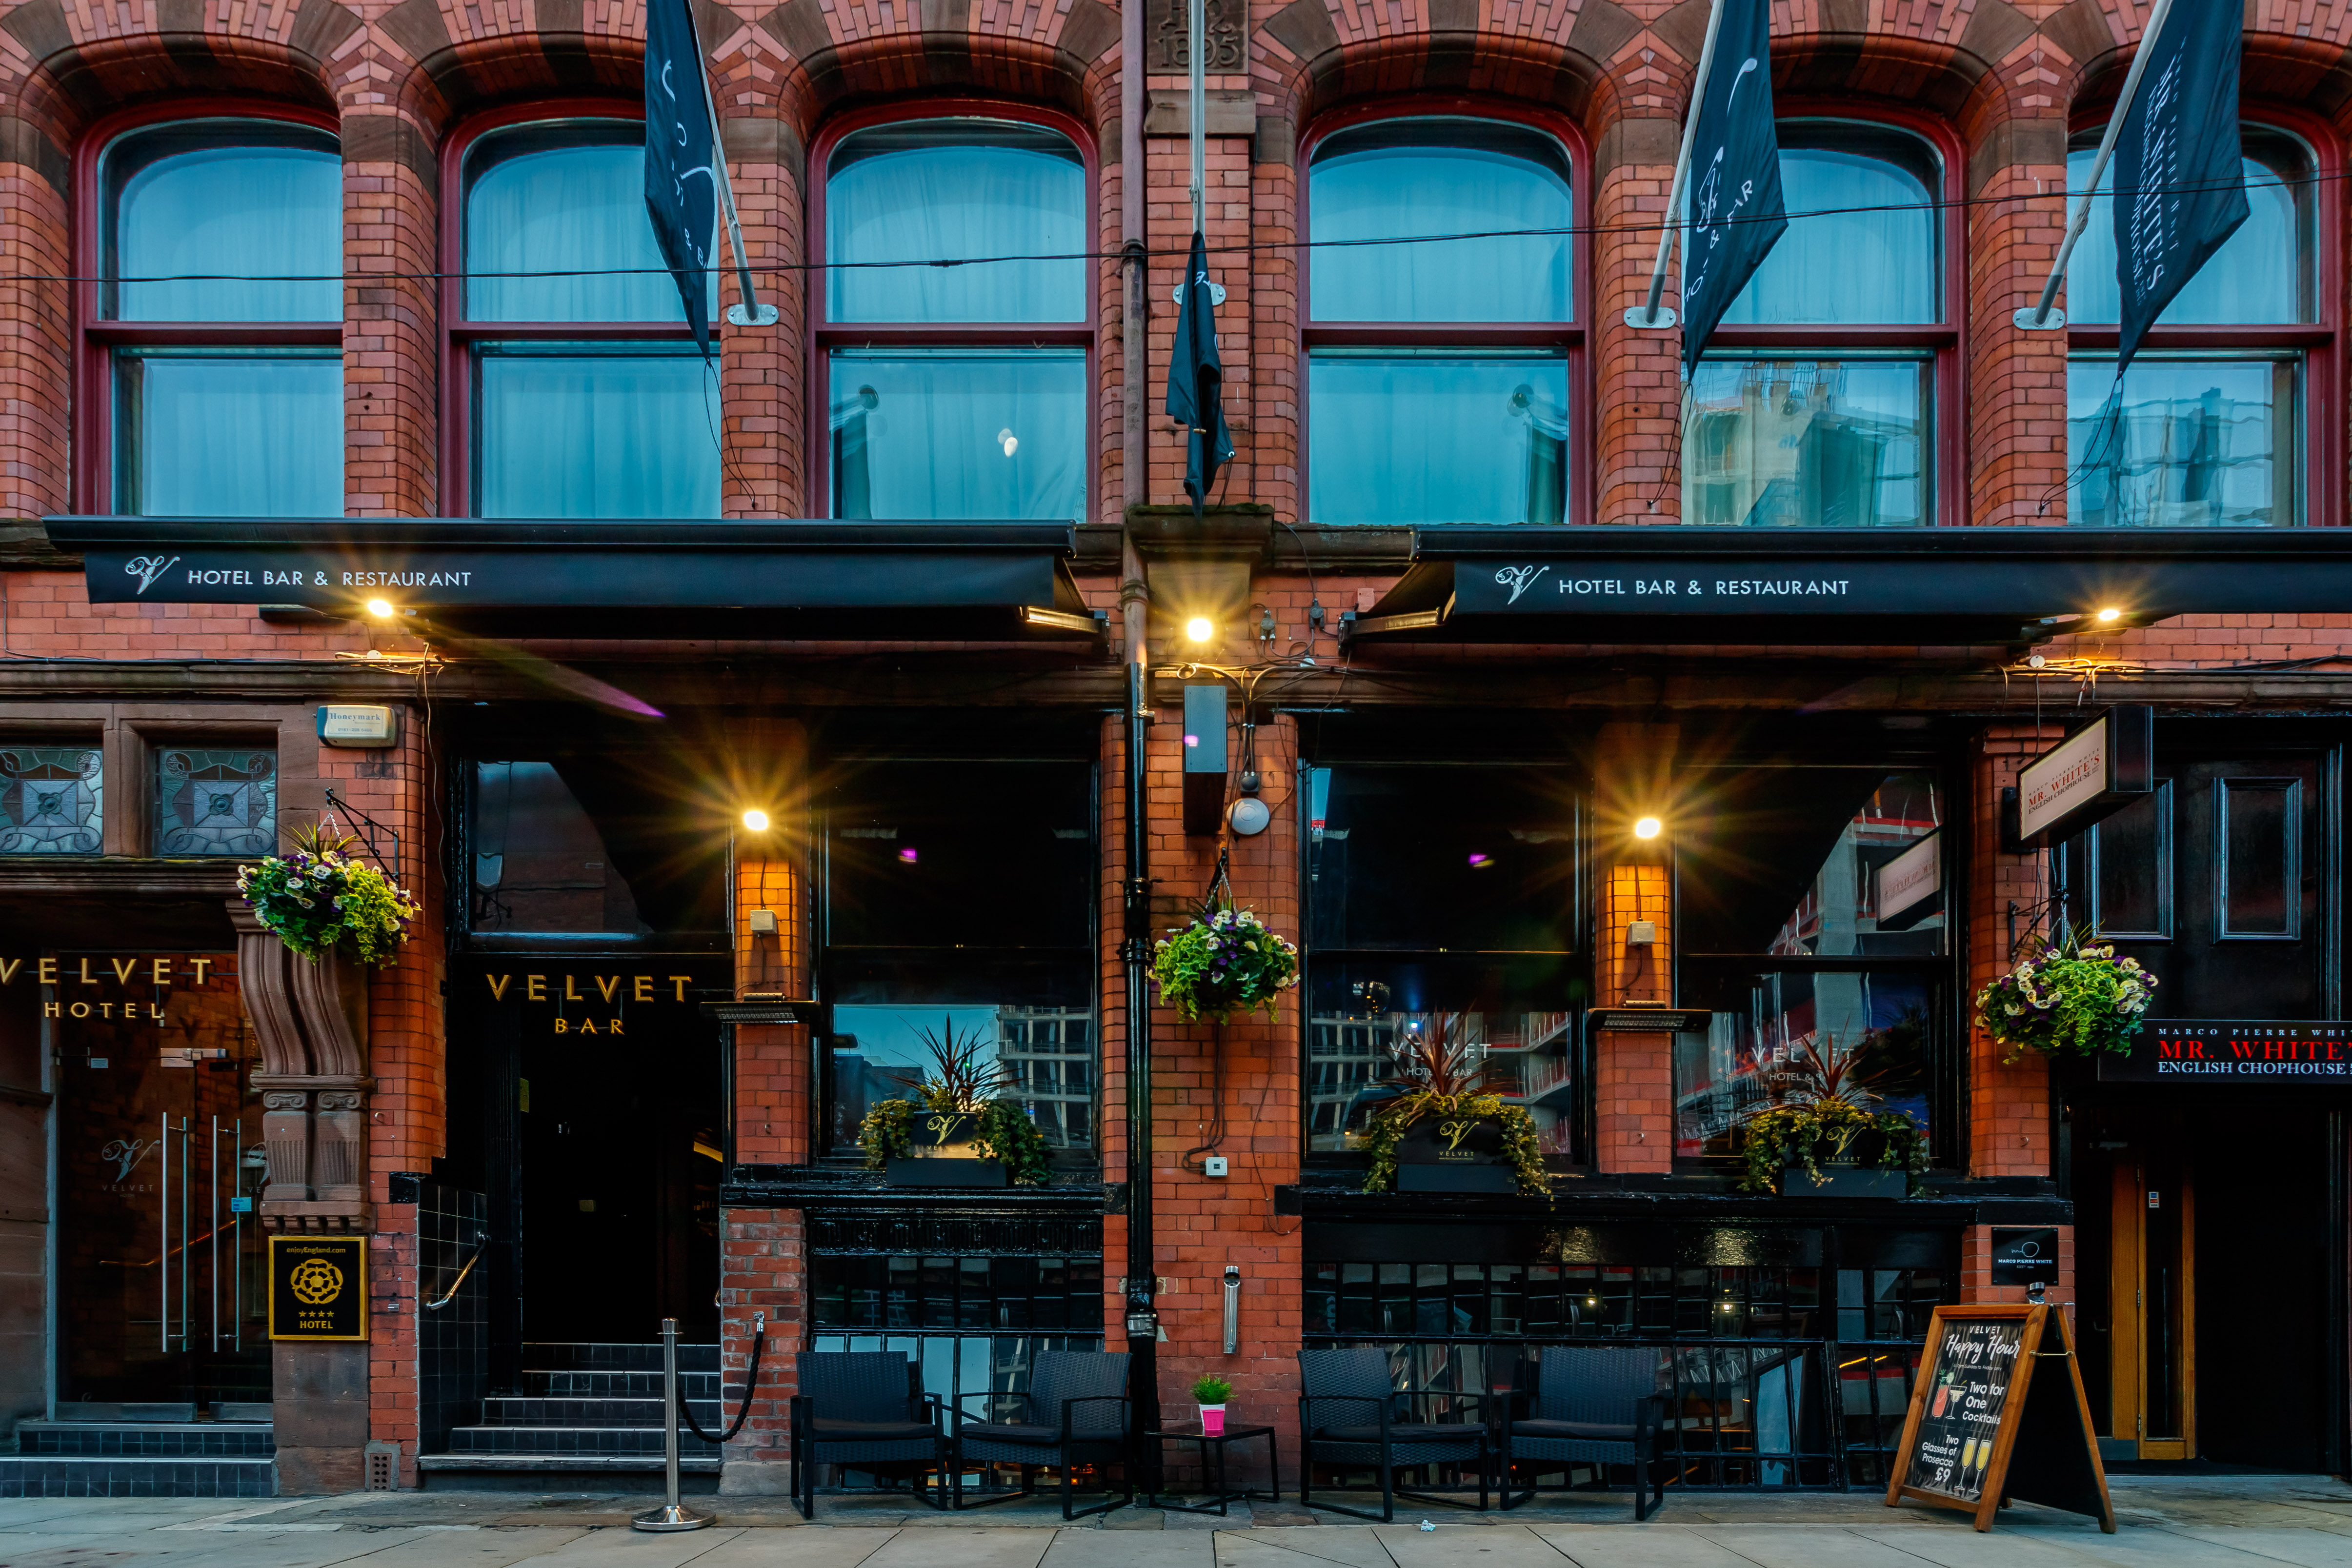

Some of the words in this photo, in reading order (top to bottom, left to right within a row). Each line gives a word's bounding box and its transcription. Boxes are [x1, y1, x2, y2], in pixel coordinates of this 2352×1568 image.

[2143, 126, 2166, 290] WHITE'S
[188, 570, 253, 584] HOTEL
[263, 570, 303, 585] BAR
[314, 571, 328, 585] &
[342, 571, 471, 586] RESTAURANT
[1559, 580, 1626, 594] HOTEL
[1636, 580, 1676, 594] BAR
[1688, 580, 1702, 595] &
[1716, 580, 1849, 595] RESTAURANT
[330, 713, 381, 722] Honeymark
[2029, 782, 2048, 796] MARCO
[2052, 764, 2074, 781] PIERRE
[2078, 747, 2099, 763] WHITE
[2029, 791, 2047, 807] MR.
[2051, 754, 2100, 791] WHITE'S
[2029, 795, 2053, 814] ENGLISH
[2054, 770, 2091, 798] CHOPHOUSE
[0, 957, 211, 985] VELVET
[486, 974, 692, 1003] VELVET
[44, 1002, 161, 1019] HOTEL
[555, 1018, 625, 1035] BAR
[1389, 1042, 1491, 1061] VEVET
[2159, 1041, 2214, 1058] MR.
[2158, 1062, 2233, 1073] ENGLISH
[2238, 1062, 2346, 1074] CHOPHOUSE
[1946, 1334, 1984, 1364] Happy
[1987, 1335, 2020, 1361] Hour
[1970, 1382, 1987, 1394] Two
[1990, 1383, 2005, 1395] for
[1966, 1396, 1987, 1408] One
[1962, 1411, 2001, 1425] Cocktails
[1946, 1435, 1959, 1445] Two
[1922, 1442, 1948, 1454] Glasses
[1949, 1447, 1957, 1456] of
[1922, 1453, 1953, 1467] Prosecco
[1934, 1467, 1950, 1482] £9
